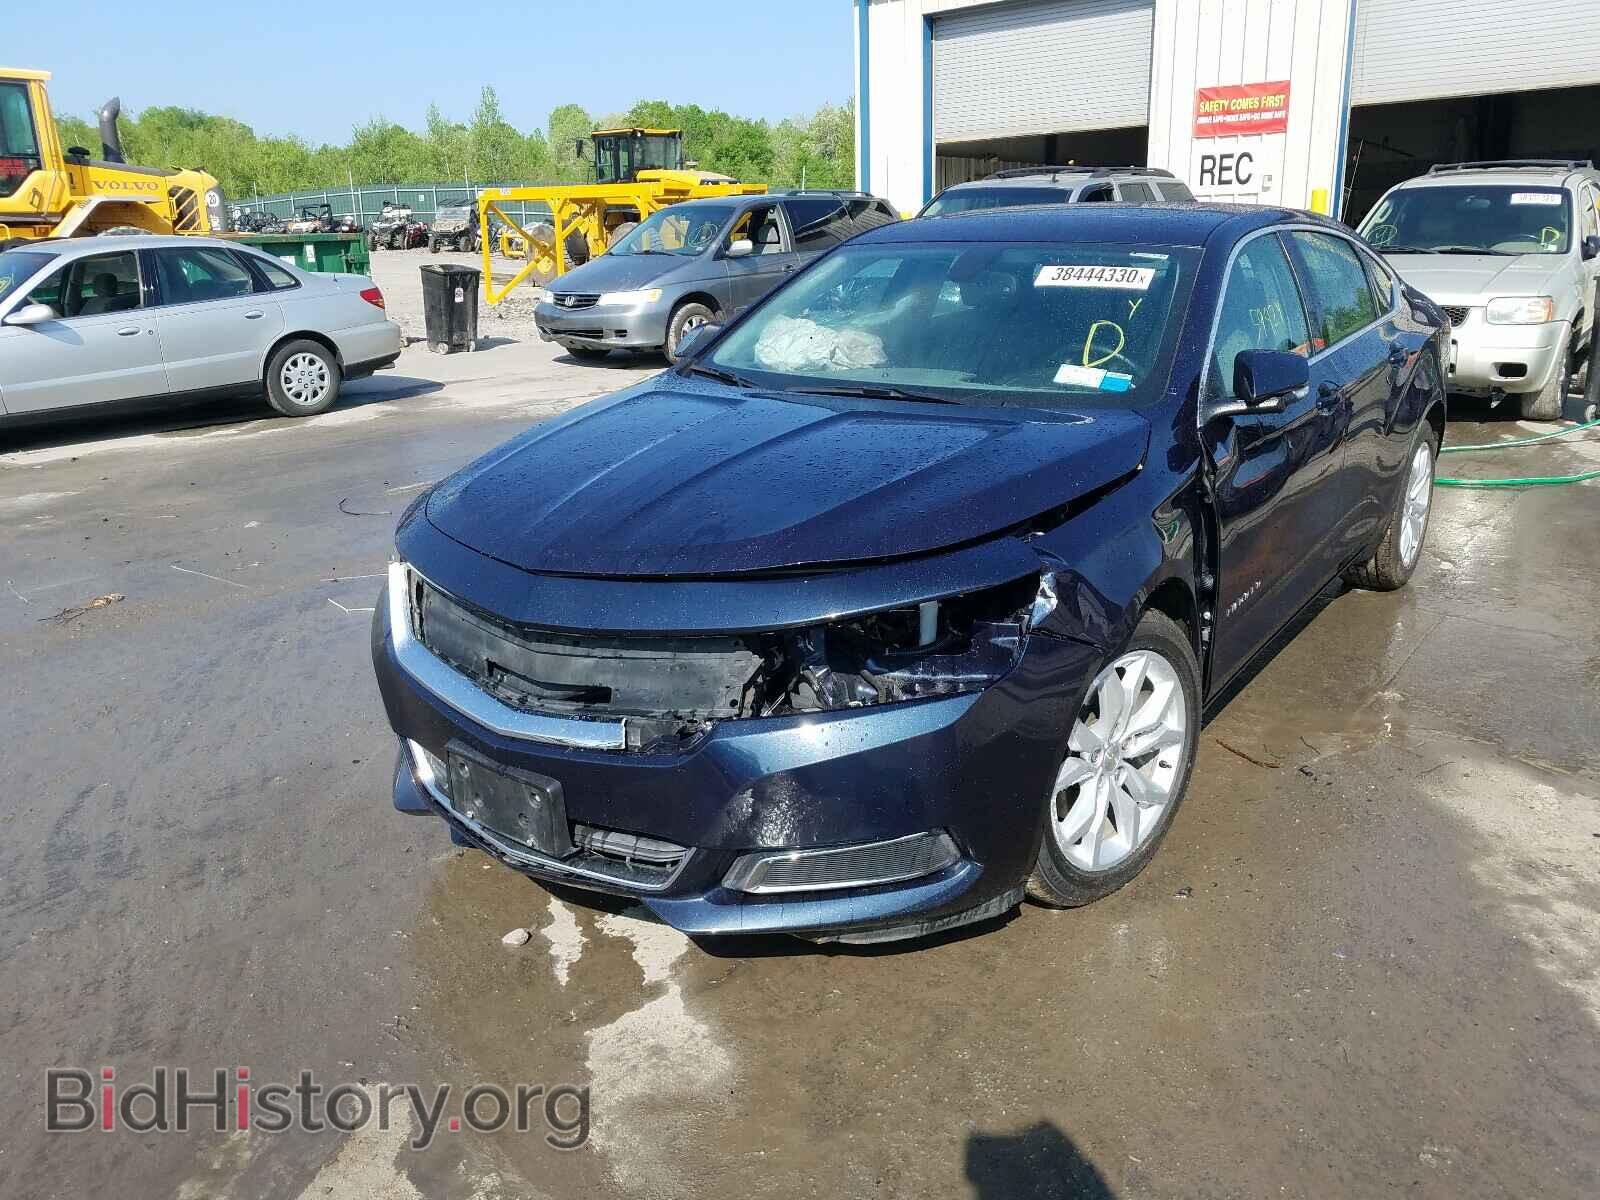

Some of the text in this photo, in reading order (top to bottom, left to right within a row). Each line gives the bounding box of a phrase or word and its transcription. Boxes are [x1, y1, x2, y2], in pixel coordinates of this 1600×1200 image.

[1199, 94, 1286, 113] SAFETY COMES FIRST
[1199, 151, 1253, 186] REC
[92, 180, 160, 191] VOLVO
[1051, 267, 1138, 283] 38444330
